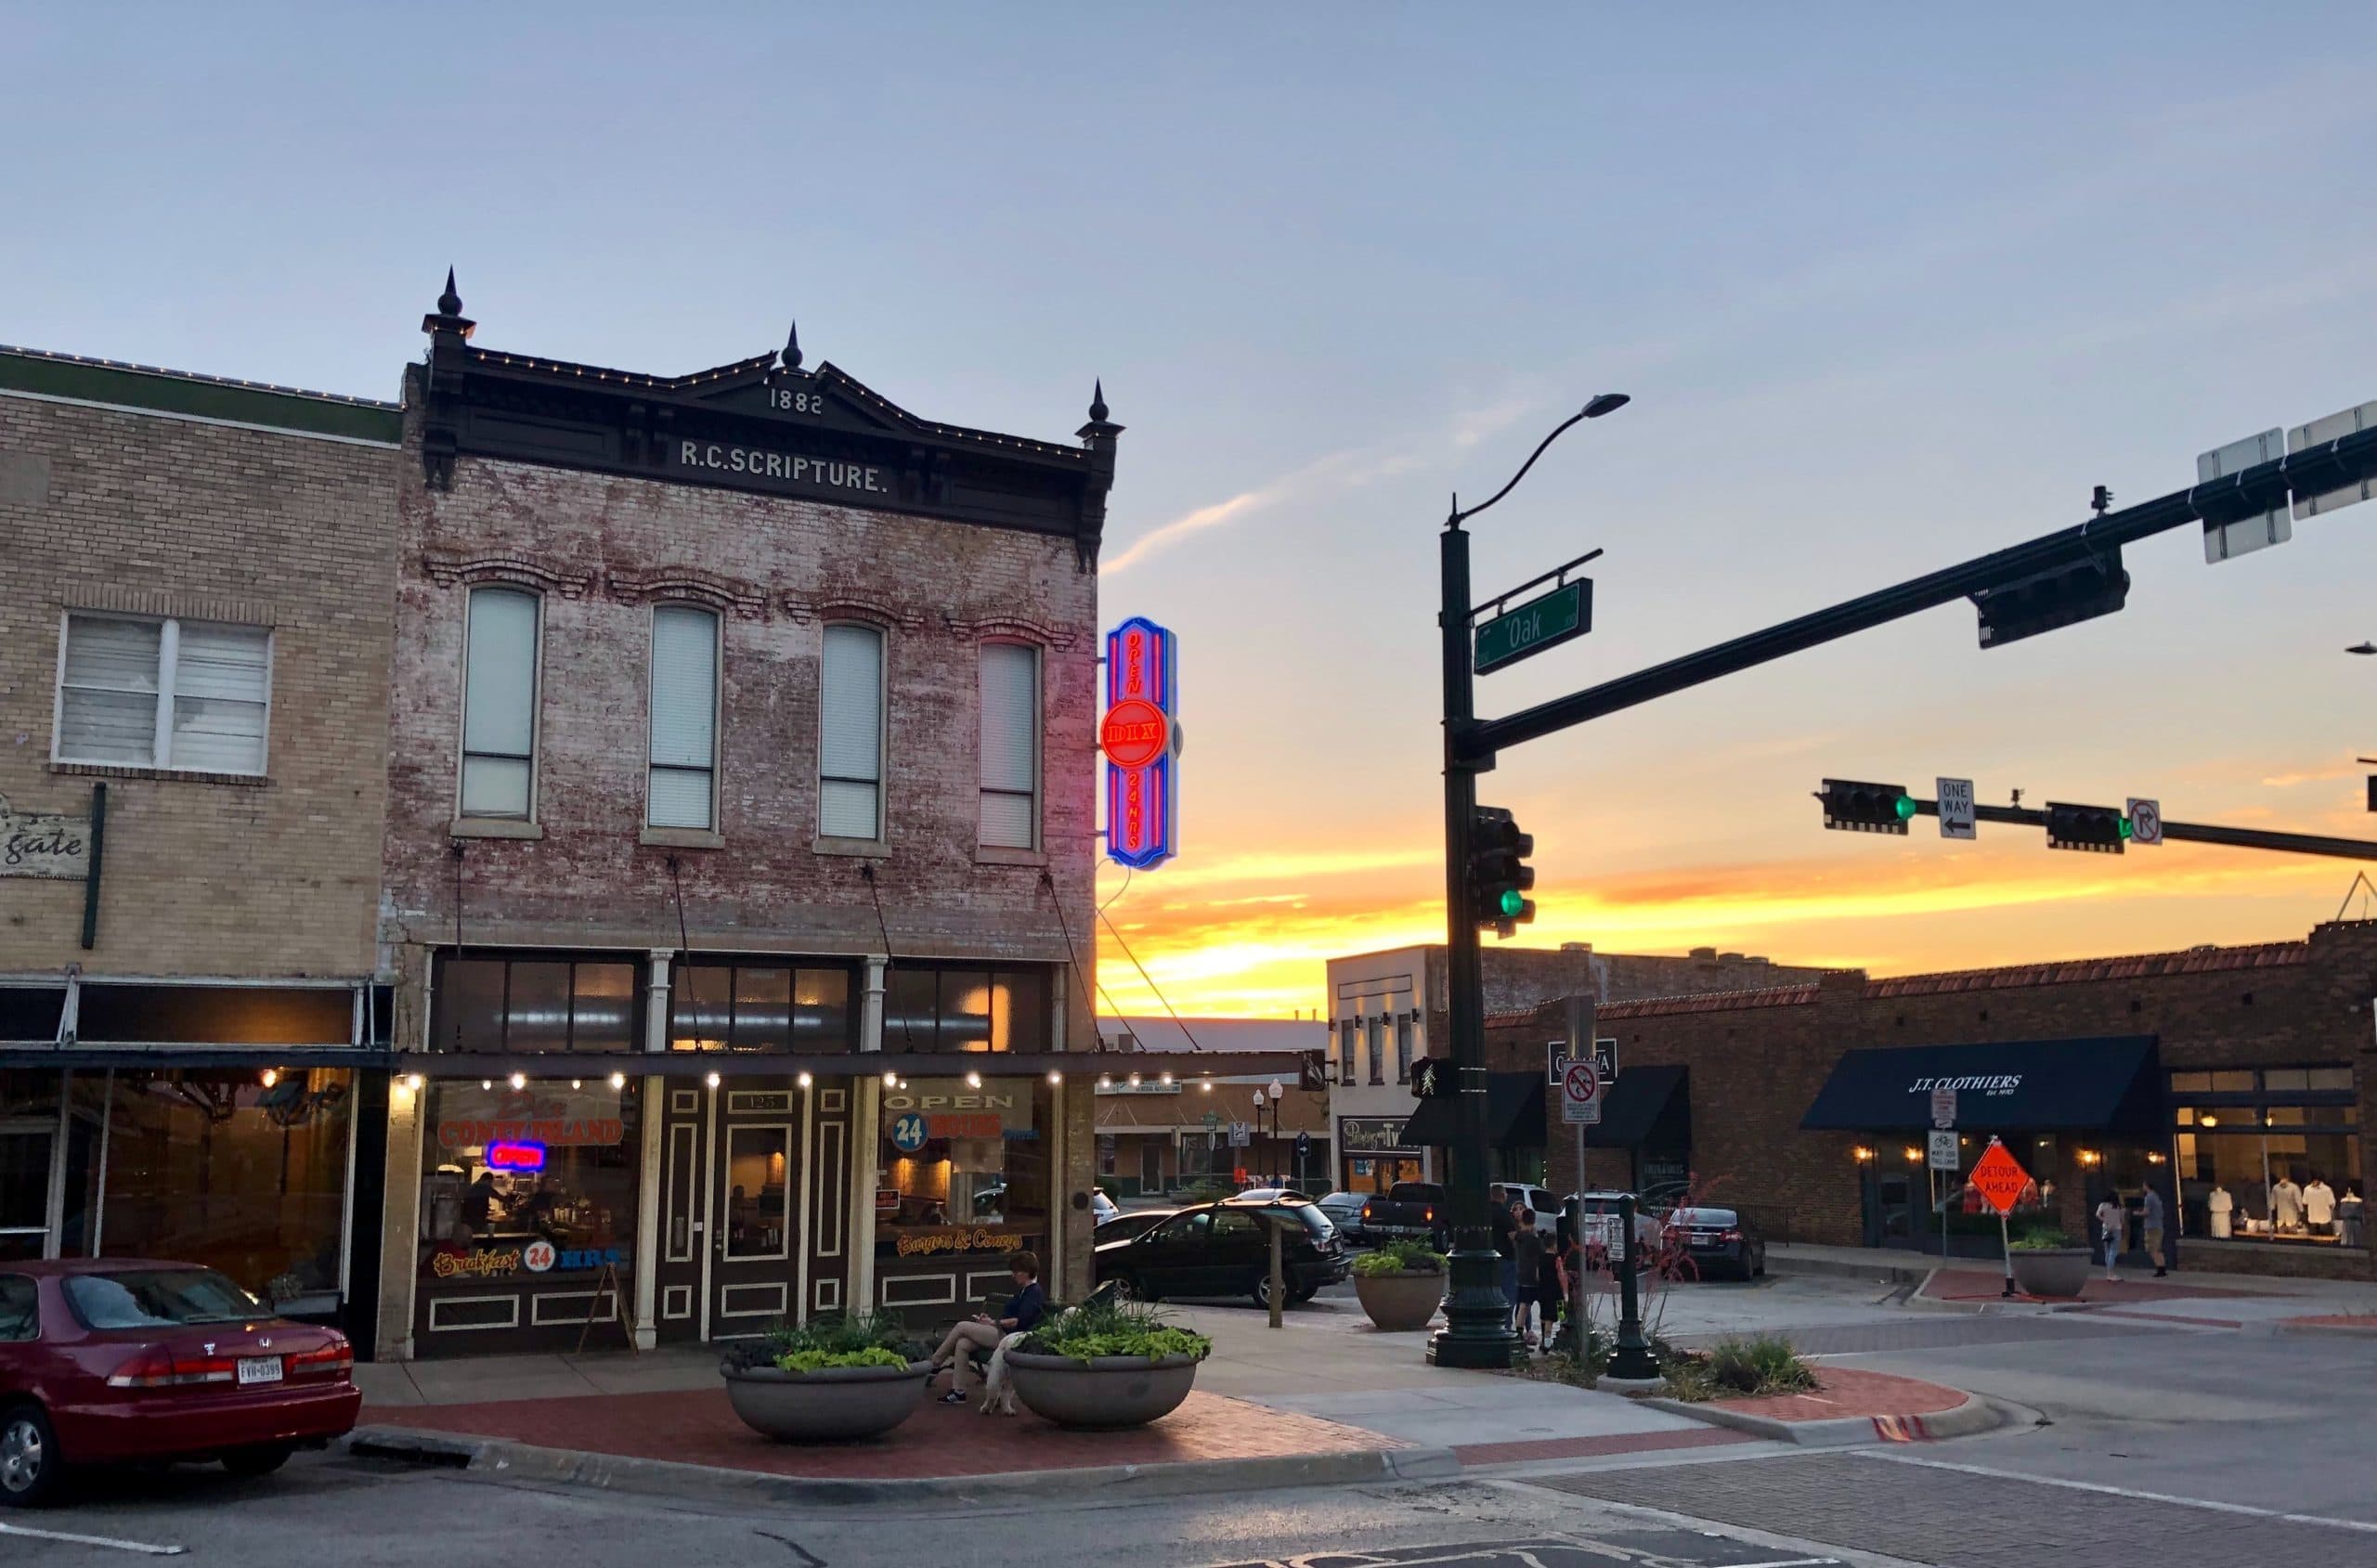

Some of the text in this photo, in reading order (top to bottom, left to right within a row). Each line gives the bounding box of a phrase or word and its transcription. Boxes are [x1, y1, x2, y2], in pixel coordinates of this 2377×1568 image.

[770, 387, 824, 415] 1882
[1510, 610, 1541, 648] Oak
[1127, 633, 1142, 693] OPEN
[1942, 784, 1968, 798] ONE
[1943, 799, 1968, 814] WAY
[1934, 1075, 2022, 1091] CLOTHIERS
[883, 1095, 1015, 1110] OPEN
[896, 1118, 923, 1146] 24
[1981, 1166, 2019, 1177] DETOUR
[1985, 1181, 2018, 1194] AHEAD
[433, 1248, 521, 1277] Breakfast
[528, 1246, 552, 1268] 24
